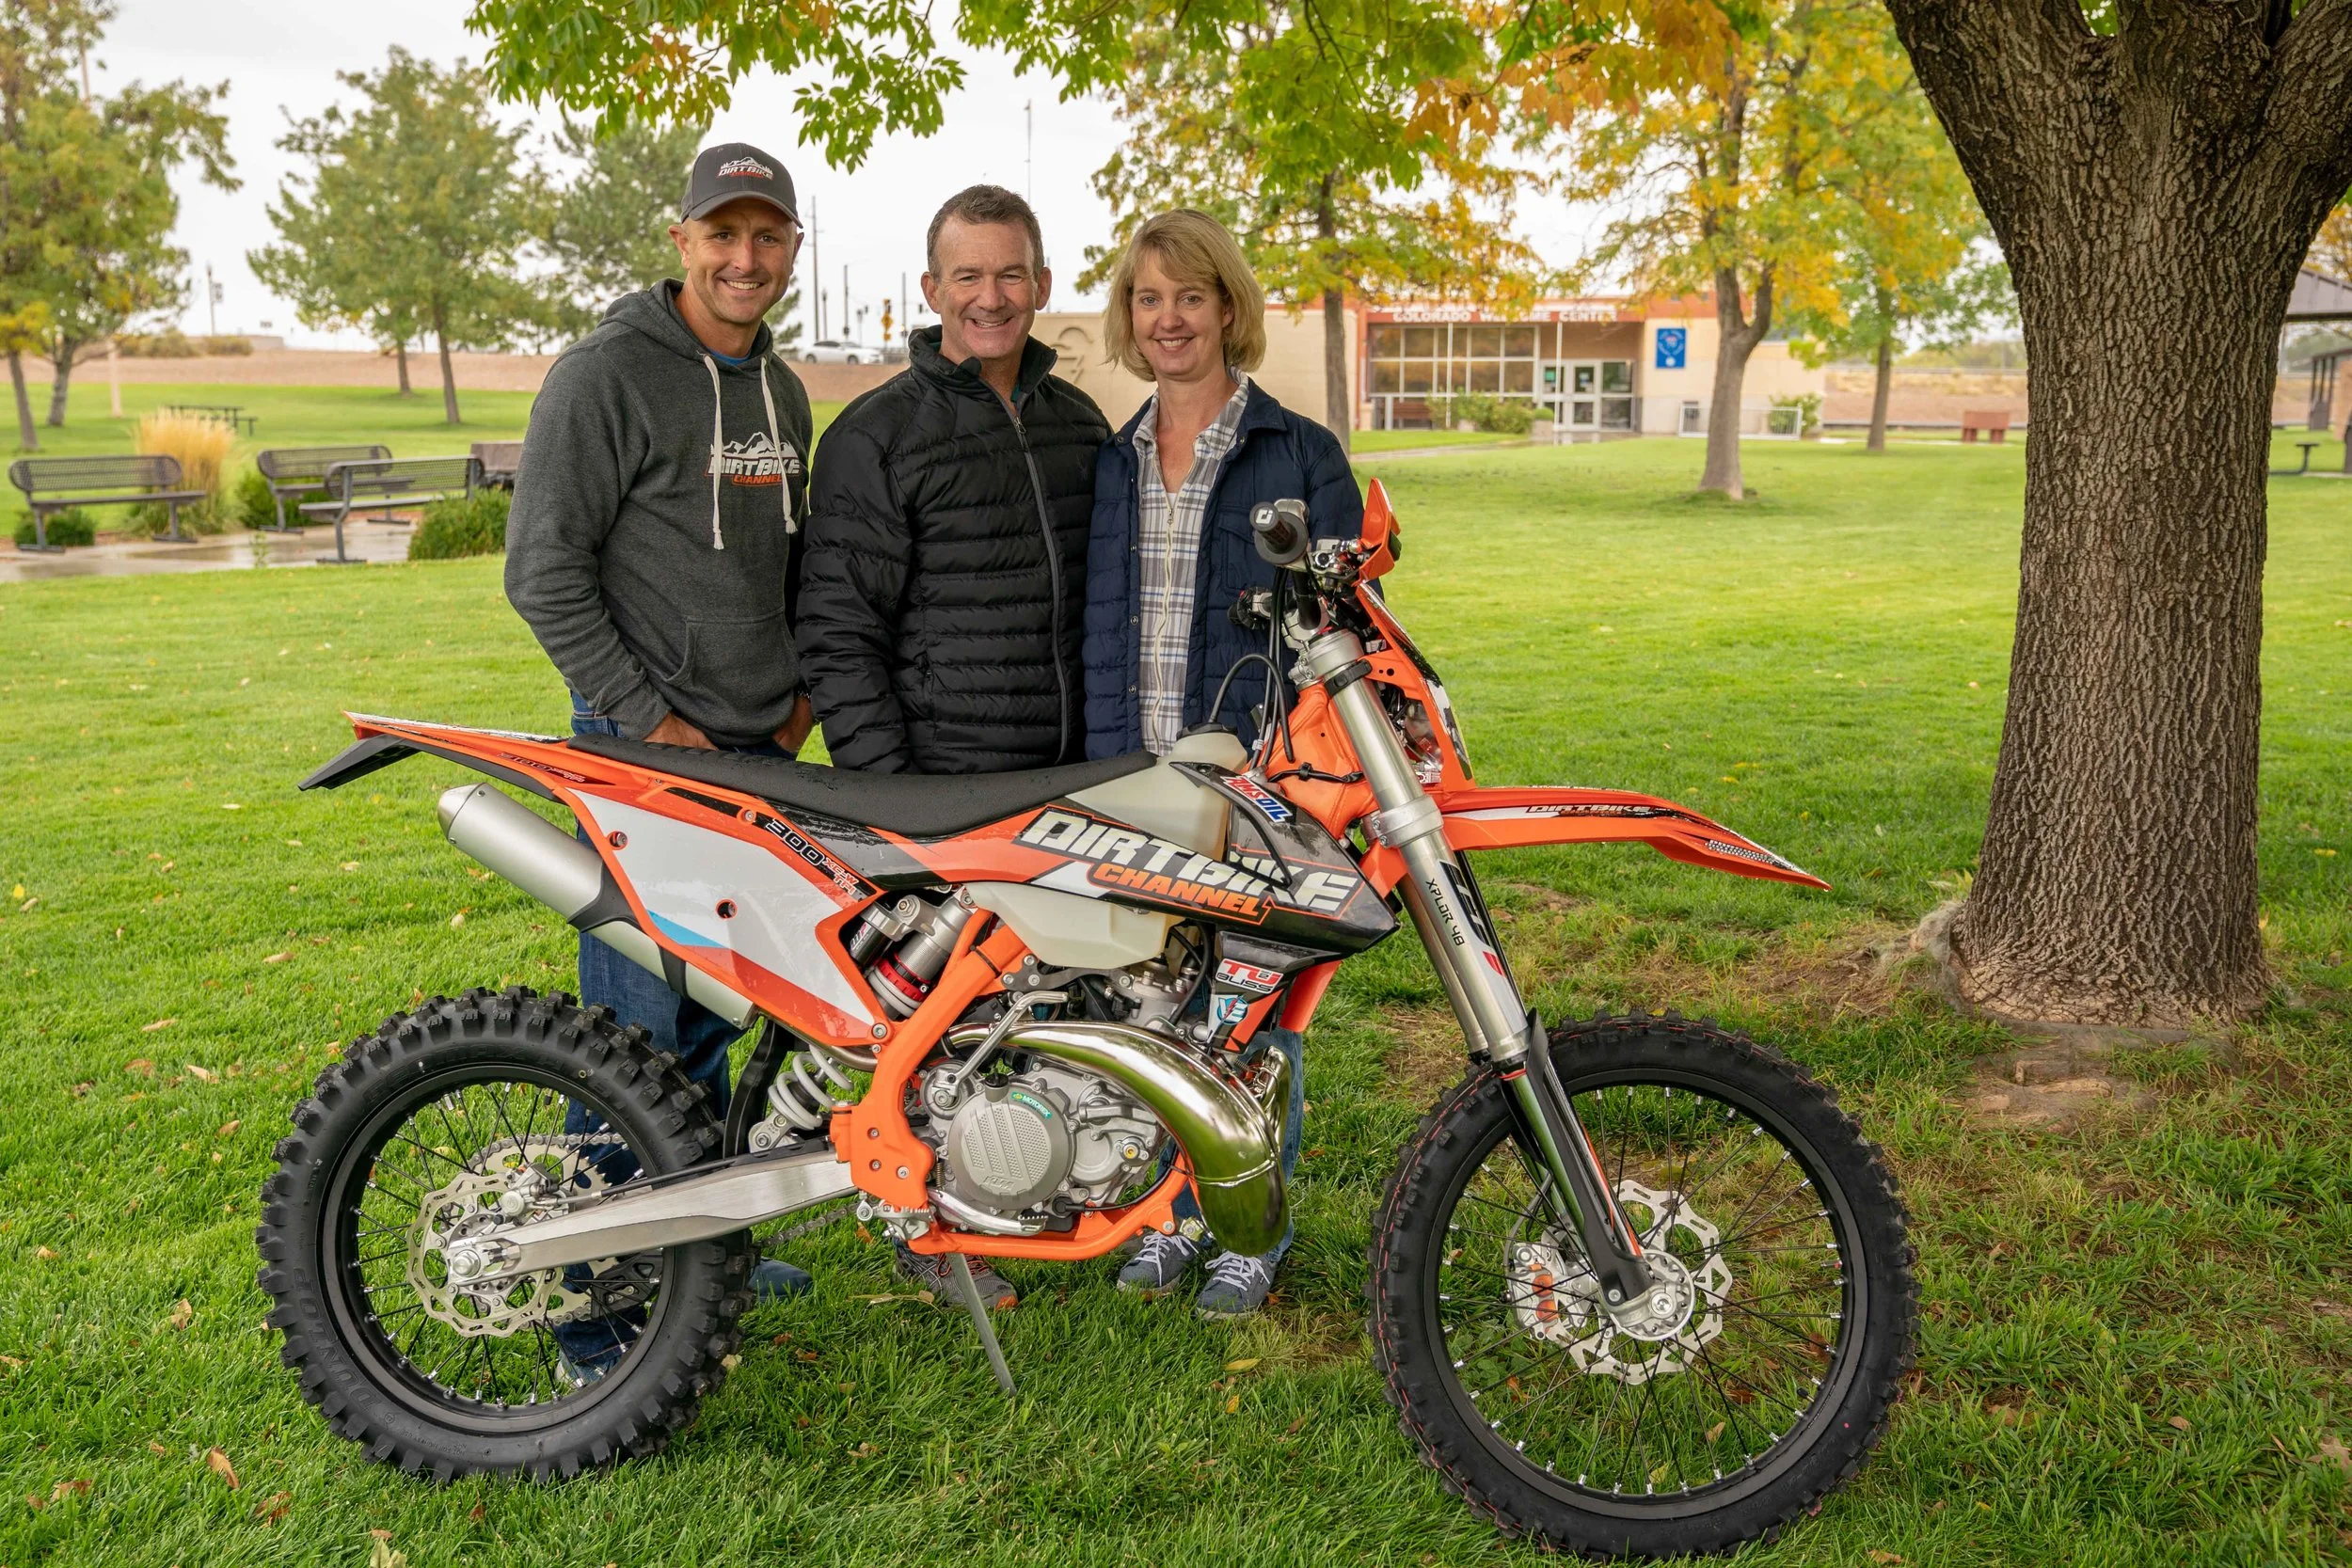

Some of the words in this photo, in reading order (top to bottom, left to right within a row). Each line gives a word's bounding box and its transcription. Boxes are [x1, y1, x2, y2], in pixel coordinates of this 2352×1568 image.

[1392, 309, 1471, 323] COLORADO
[1480, 309, 1551, 323] WEOME
[1224, 776, 1289, 821] AMSOIL
[765, 818, 826, 866] 300
[1020, 810, 1359, 911] DIRTBIKE
[833, 873, 858, 895] TPI
[1092, 863, 1261, 917] CHANNEL
[1425, 878, 1454, 924] XPLOR
[1450, 925, 1465, 946] 48
[1216, 972, 1274, 992] BLISS
[1022, 1095, 1051, 1117] MOTOREX
[293, 1266, 384, 1414] DUNLOP
